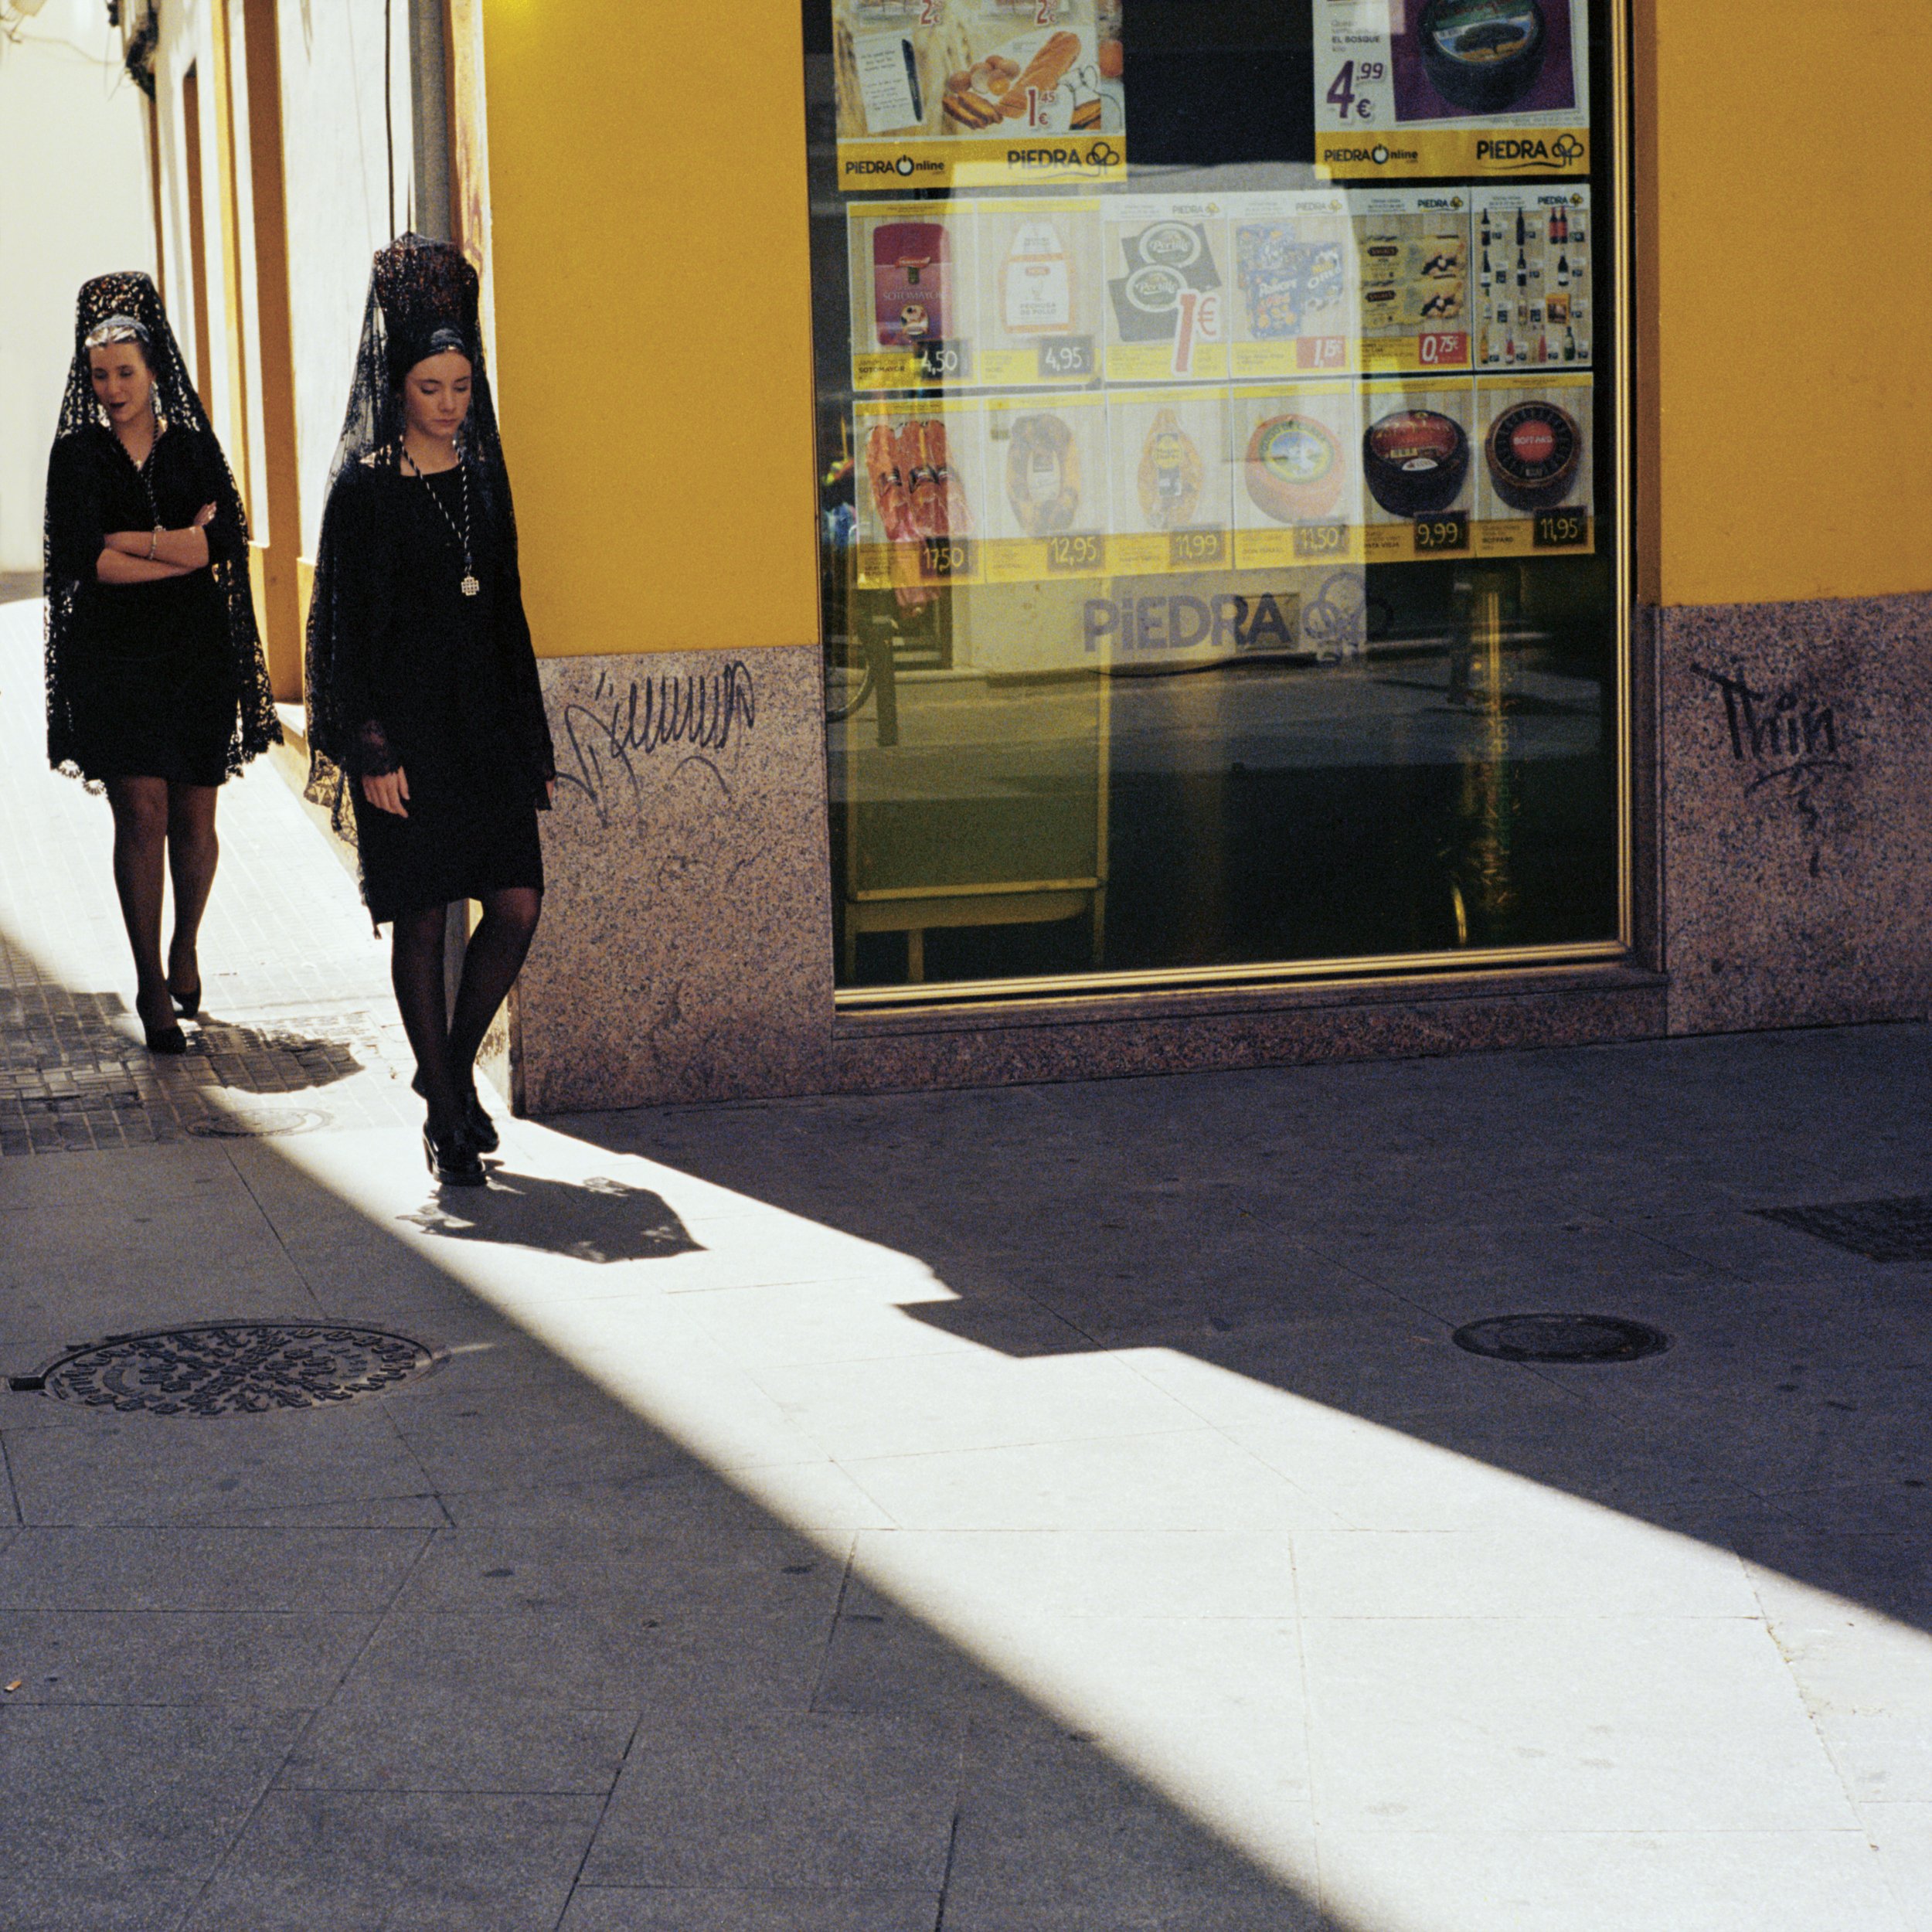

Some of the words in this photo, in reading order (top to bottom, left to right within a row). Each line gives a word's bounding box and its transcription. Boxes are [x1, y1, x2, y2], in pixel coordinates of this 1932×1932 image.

[1345, 36, 1380, 44] BOSQUE
[922, 350, 957, 376] 4,50
[1046, 347, 1083, 372] 4,95
[1301, 527, 1338, 552] 11,50
[1417, 522, 1458, 547] 9,99
[1540, 518, 1578, 541] 11,95
[1049, 536, 1097, 566] 12,95
[1175, 534, 1217, 559] 11,99
